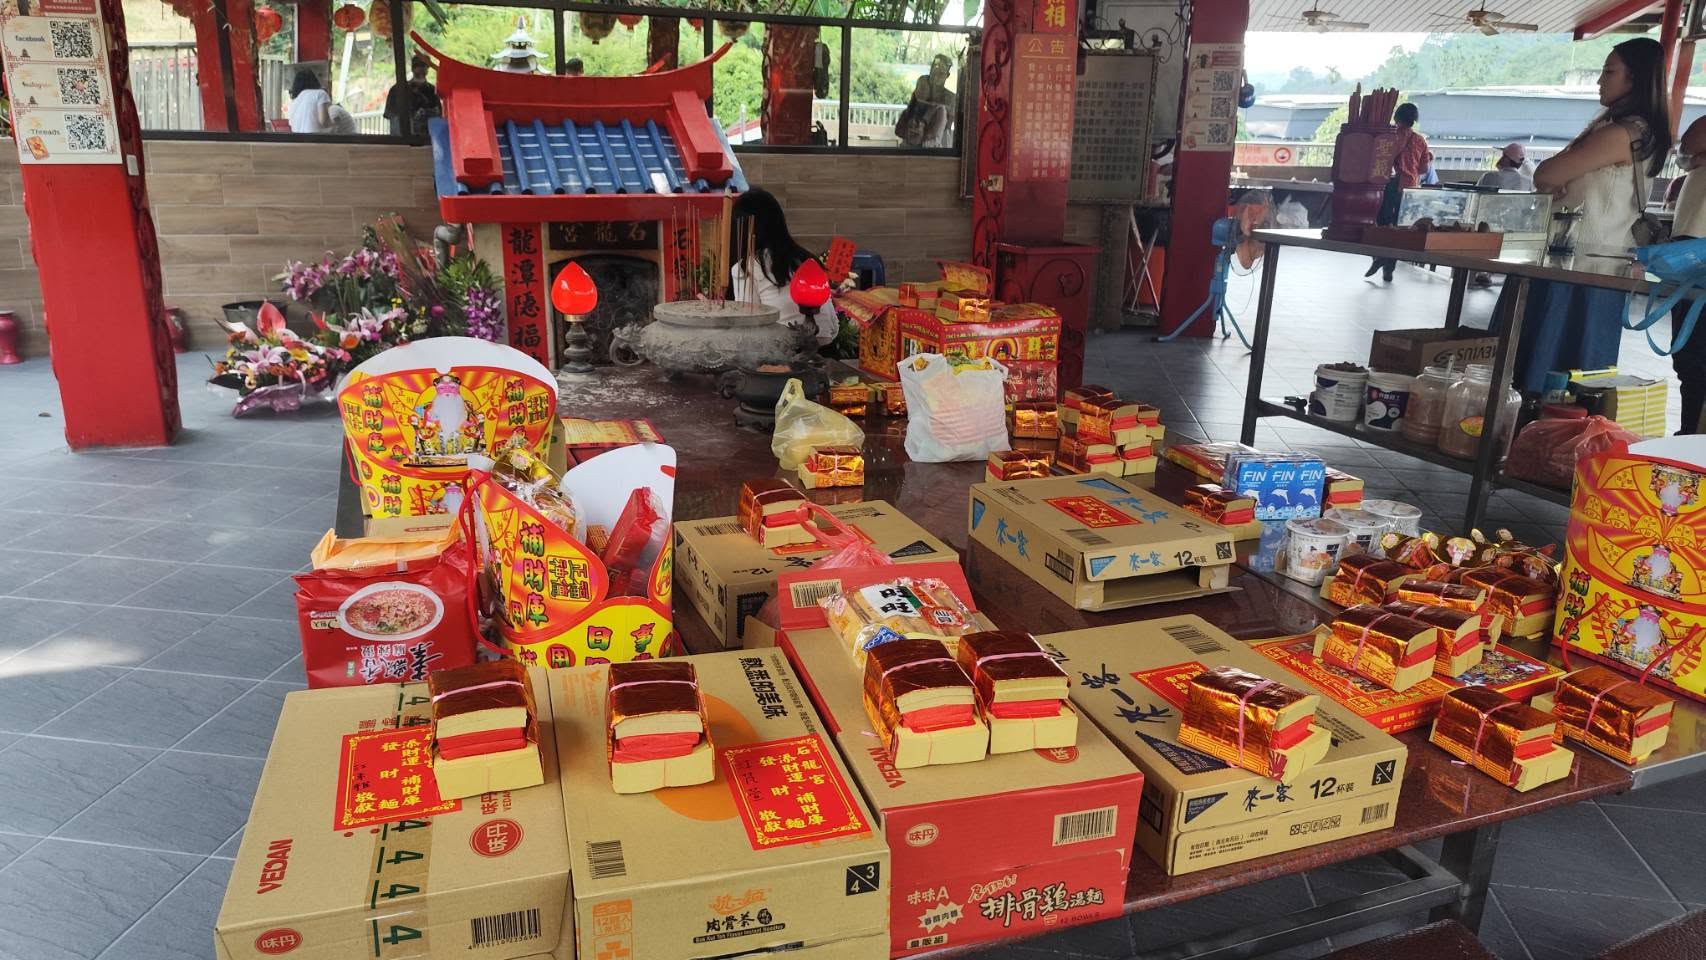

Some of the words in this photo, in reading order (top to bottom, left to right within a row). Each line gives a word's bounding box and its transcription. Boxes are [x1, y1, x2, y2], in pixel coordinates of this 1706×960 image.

[1029, 38, 1064, 54] 公告
[1243, 471, 1267, 482] FIN
[1272, 471, 1295, 482] FIN
[1301, 470, 1323, 481] FIN
[1129, 551, 1167, 571] 來一客
[520, 521, 549, 627] 補財庫
[880, 586, 913, 613] 旺旺
[738, 656, 788, 721] 熟悉的美味
[797, 746, 825, 785] 石龍宮
[1385, 762, 1393, 773] 4
[1375, 774, 1383, 785] 5
[1243, 783, 1295, 813] 來一客
[487, 823, 508, 853] 味丹
[908, 828, 935, 841] 味丹
[386, 849, 425, 866] 4
[257, 838, 293, 895] VEDAN
[865, 865, 875, 878] 3
[380, 883, 420, 899] 4
[851, 881, 860, 894] 4
[907, 885, 949, 905] 味味A
[706, 911, 755, 933] 肉骨茶
[261, 935, 297, 950] 味丹
[383, 925, 422, 946] 4
